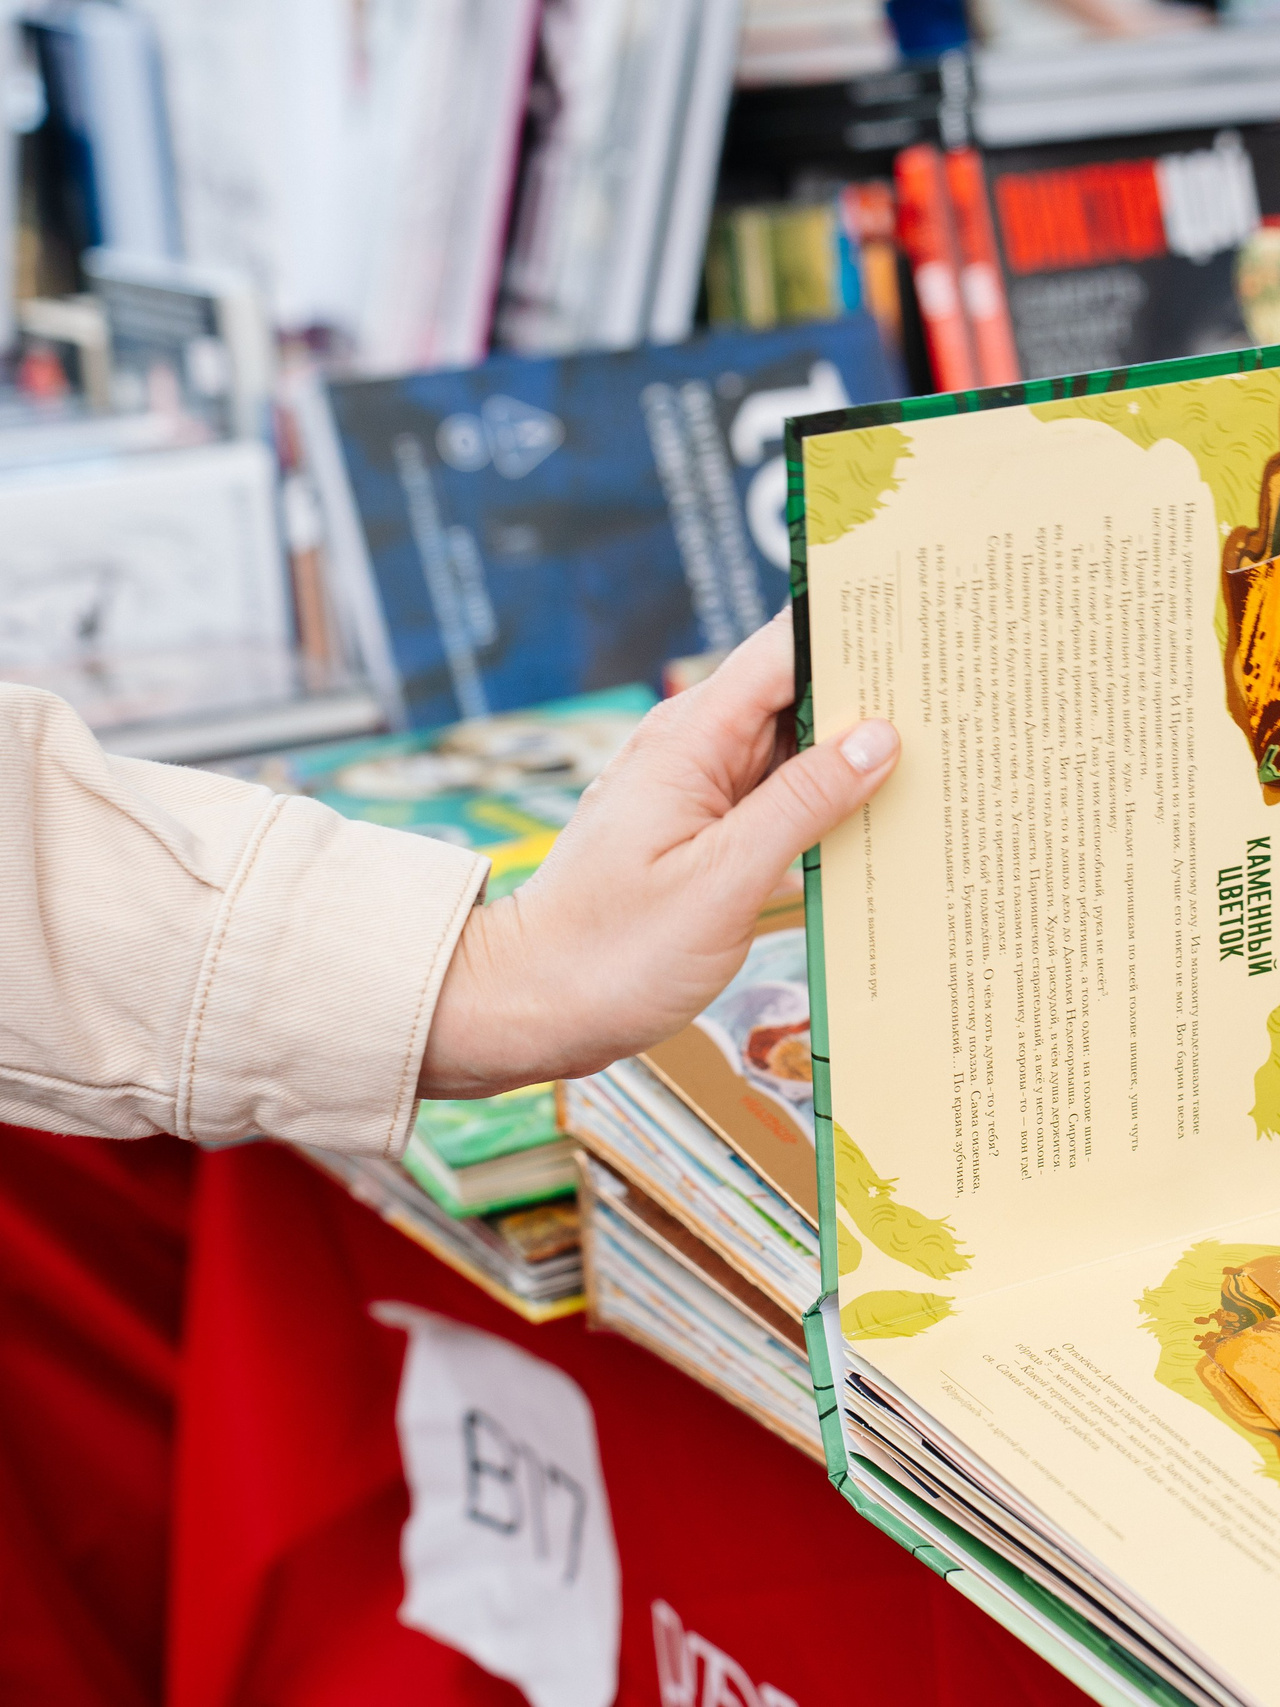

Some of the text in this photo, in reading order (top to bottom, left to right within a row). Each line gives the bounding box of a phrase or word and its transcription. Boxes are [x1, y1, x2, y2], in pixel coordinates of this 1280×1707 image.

[863, 800, 871, 834] елать
[1216, 865, 1244, 962] ЦВЕТОК
[1247, 836, 1277, 977] КАМЕННЫЙ
[867, 916, 875, 961] валится
[1095, 938, 1104, 955] не
[1127, 943, 1136, 961] по
[1173, 929, 1182, 969] никто
[1189, 935, 1201, 954] Из
[869, 962, 876, 976] из
[982, 967, 994, 981] О
[1061, 943, 1076, 1005] Данилки
[1080, 975, 1089, 984] а
[1127, 962, 1139, 992] всей
[1174, 971, 1183, 987] не
[962, 969, 976, 1033] листочку
[982, 982, 995, 1009] чём
[1080, 986, 1089, 1017] толк
[1186, 956, 1199, 1018] малахиту
[983, 1011, 993, 1042] хоть
[1128, 995, 1137, 1038] голове
[1017, 1030, 1025, 1039] а
[1049, 1032, 1058, 1040] в
[1175, 1022, 1187, 1046] Вот
[1033, 1053, 1042, 1062] а
[1049, 1041, 1062, 1067] чём
[1082, 1060, 1091, 1077] на
[1172, 1049, 1187, 1090] барин
[1189, 1019, 1200, 1097] выделывали
[952, 1071, 964, 1093] По
[981, 1043, 995, 1109] думка-то
[1014, 1041, 1027, 1114] коровы-то
[1034, 1063, 1046, 1084] всё
[1047, 1069, 1059, 1104] душа
[1031, 1085, 1043, 1095] у
[1082, 1079, 1092, 1123] голове
[1176, 1092, 1184, 1101] и
[950, 1095, 963, 1138] краям
[969, 1089, 982, 1127] Сама
[983, 1109, 995, 1119] у
[1035, 1096, 1044, 1125] него
[1127, 1092, 1139, 1120] уши
[1176, 1104, 1185, 1139] велел
[1191, 1099, 1200, 1135] такие
[986, 1119, 999, 1158] тебя?
[1019, 1129, 1029, 1153] вон
[1035, 1126, 1045, 1175] оплош-
[1048, 1105, 1061, 1172] держится.
[1064, 1111, 1080, 1169] Сиротка
[1083, 1125, 1093, 1162] шиш-
[1127, 1122, 1139, 1152] чуть
[951, 1139, 968, 1199] зубчики,
[968, 1129, 981, 1194] сизенька,
[1019, 1155, 1032, 1181] где!
[1043, 1347, 1066, 1362] Как
[981, 1354, 995, 1364] ся.
[994, 1364, 1026, 1386] Самая
[1021, 1387, 1040, 1400] там
[1036, 1400, 1052, 1410] по
[1019, 1365, 1049, 1386] Какой
[1061, 1343, 1103, 1373] Отвлёкся
[1096, 1372, 1140, 1403] Данилко
